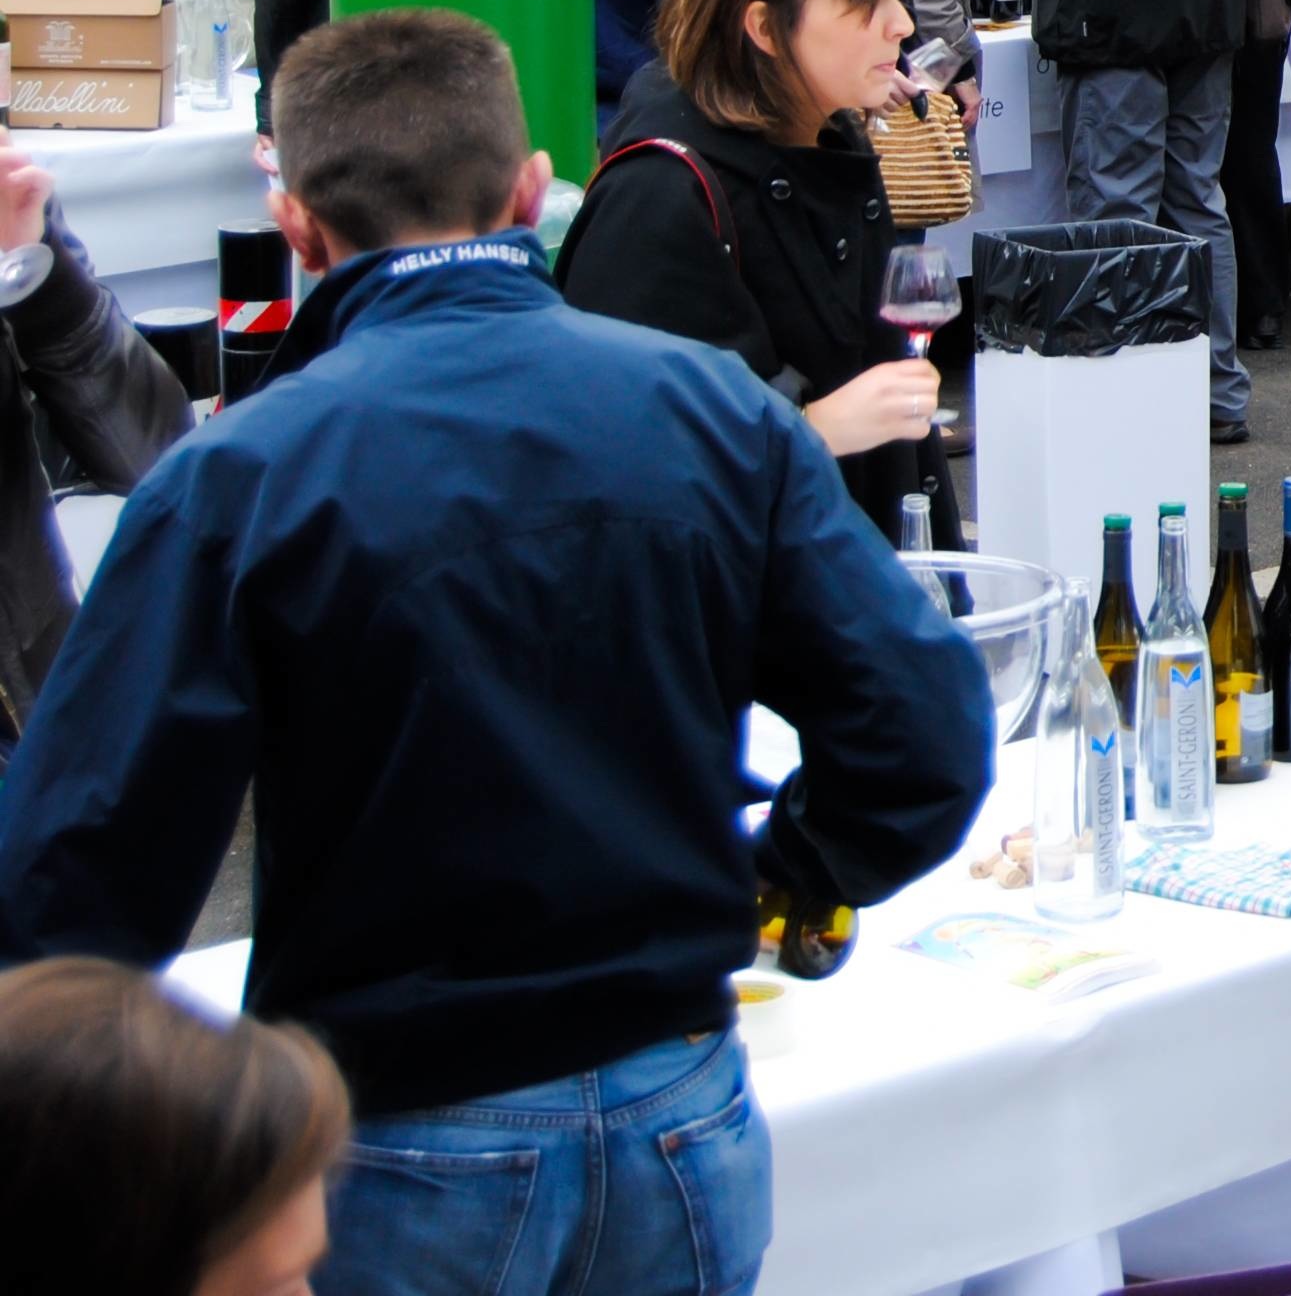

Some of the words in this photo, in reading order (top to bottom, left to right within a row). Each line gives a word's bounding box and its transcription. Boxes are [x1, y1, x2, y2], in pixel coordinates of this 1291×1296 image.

[8, 78, 134, 113] illabellini
[980, 97, 1004, 119] ite
[392, 246, 452, 275] HELLY
[456, 242, 529, 266] HANSEN
